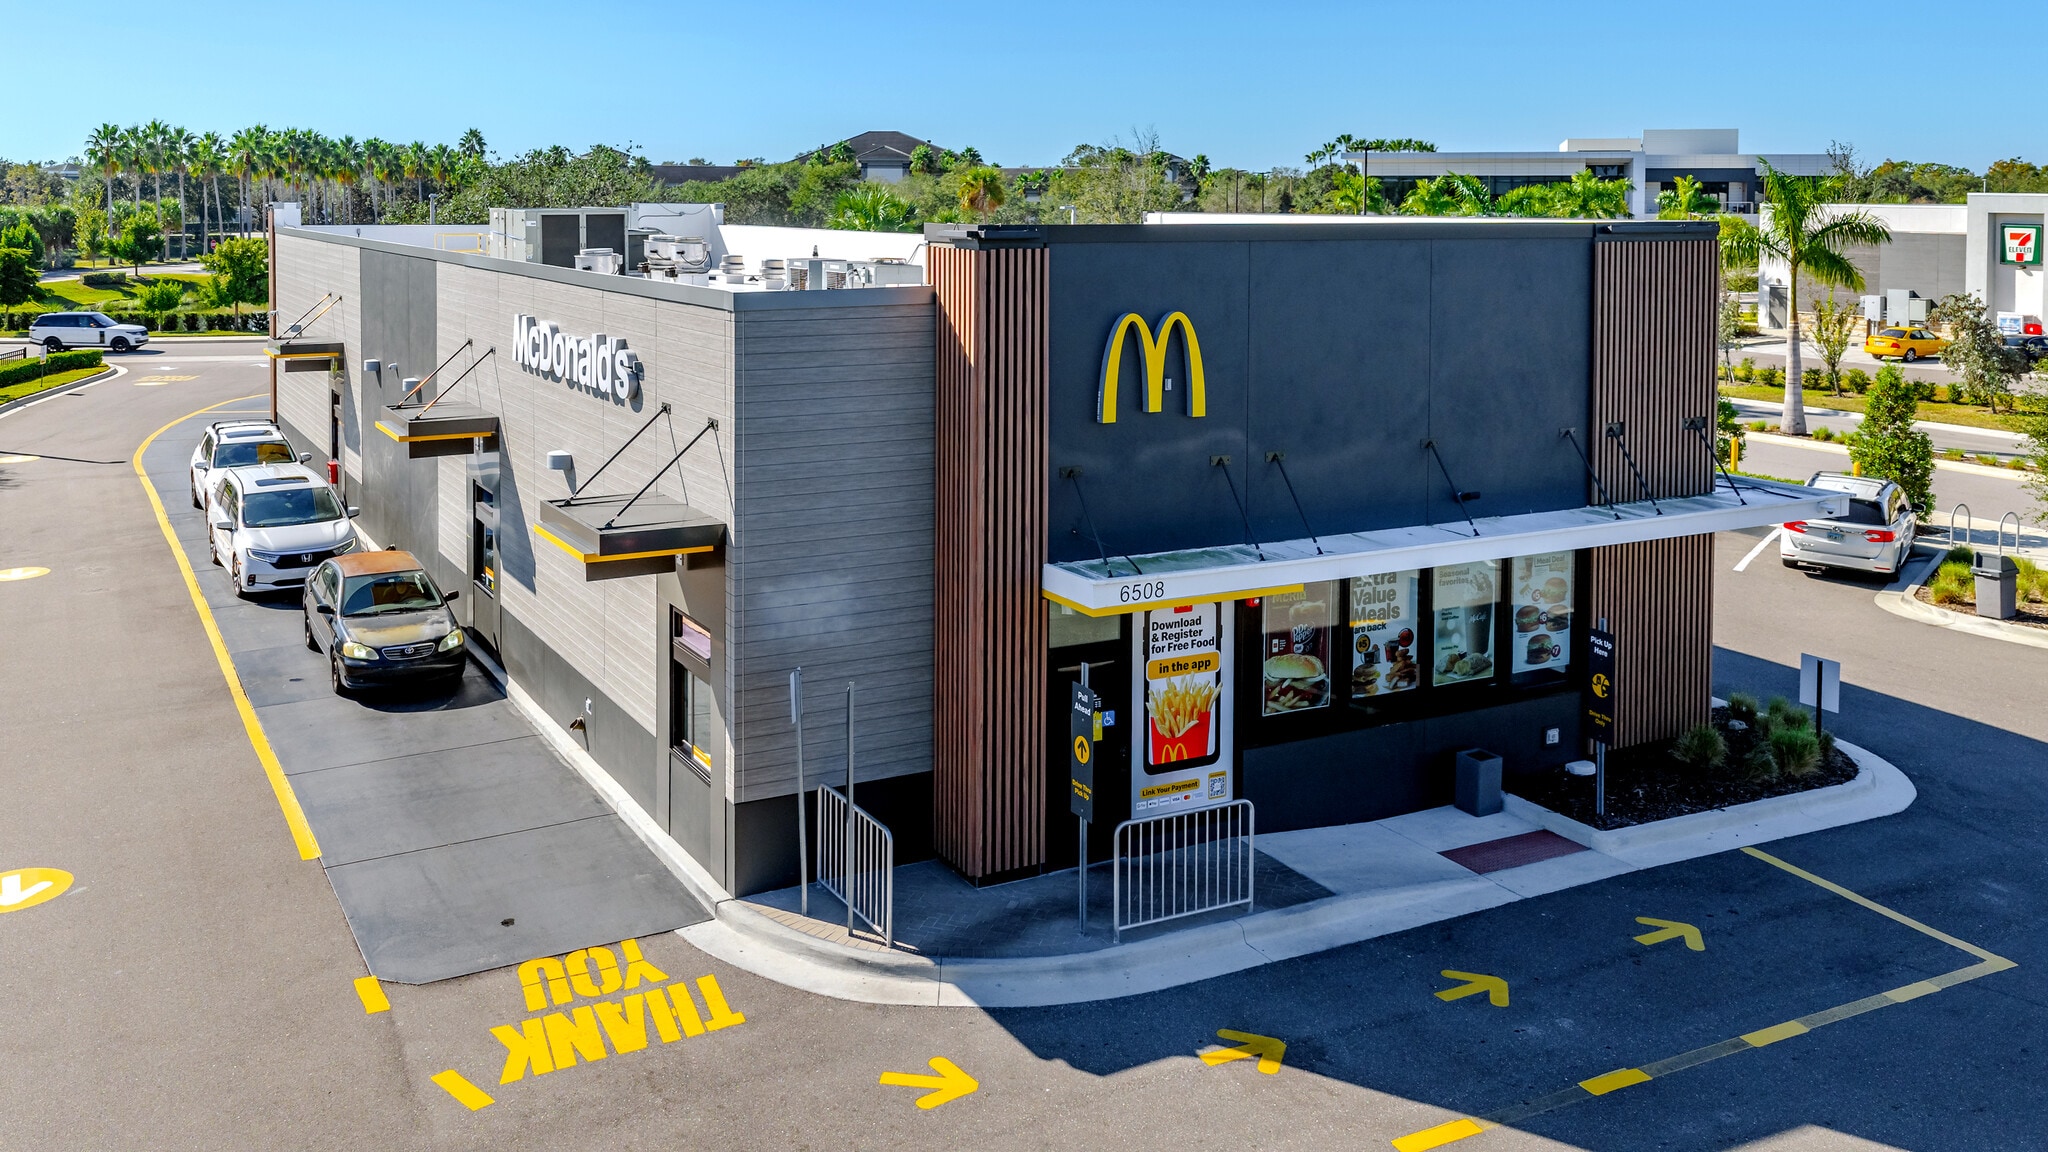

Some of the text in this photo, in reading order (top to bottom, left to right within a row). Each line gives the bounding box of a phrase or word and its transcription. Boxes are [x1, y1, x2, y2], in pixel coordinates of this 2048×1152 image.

[512, 313, 636, 400] McDonald's
[1439, 567, 1470, 579] Seasonal
[1120, 581, 1164, 603] 6508
[1353, 586, 1397, 607] Value
[1353, 603, 1400, 623] Meals
[1151, 615, 1202, 631] Download
[1353, 621, 1387, 634] are back
[1151, 628, 1203, 643] & Register
[1590, 635, 1613, 650] Pick Up
[1151, 636, 1215, 654] for Free Food
[1594, 646, 1608, 657] Here
[1159, 659, 1211, 674] in the app
[1077, 691, 1089, 703] Pull
[1074, 702, 1091, 716] Ahead
[1142, 781, 1198, 797] Link Your Payment
[517, 938, 670, 1012] YOU
[489, 974, 747, 1085] THANK
